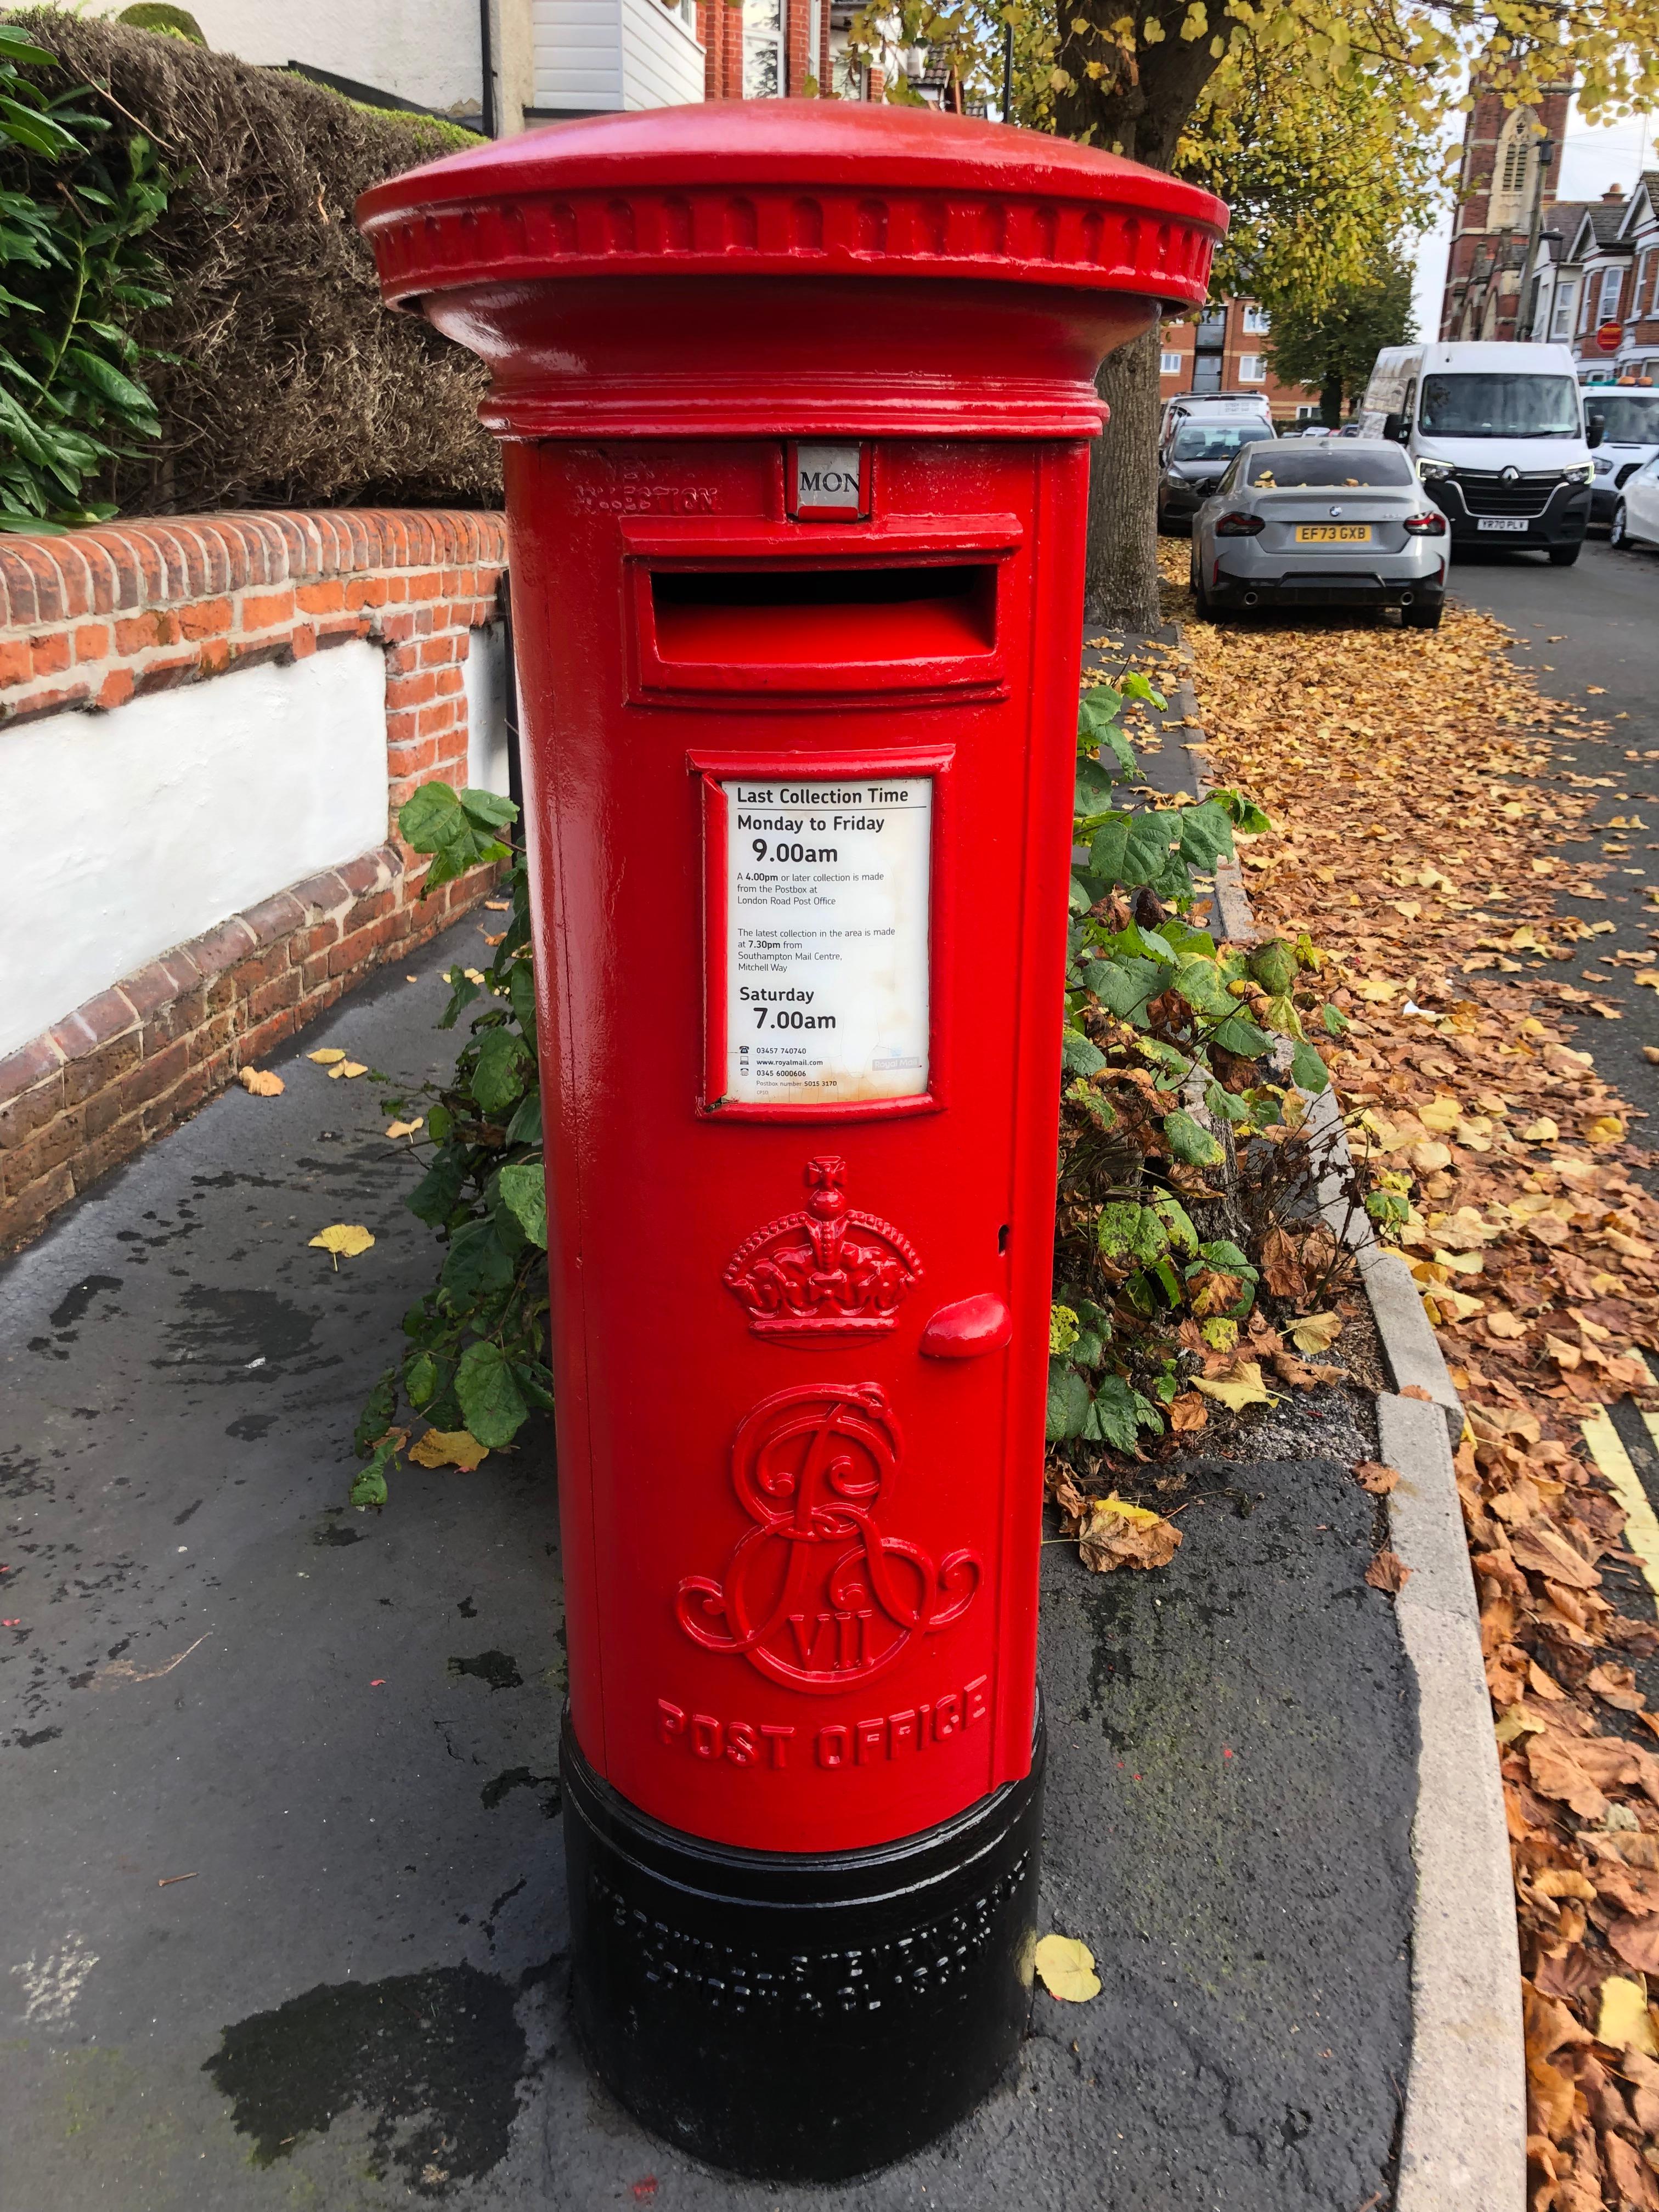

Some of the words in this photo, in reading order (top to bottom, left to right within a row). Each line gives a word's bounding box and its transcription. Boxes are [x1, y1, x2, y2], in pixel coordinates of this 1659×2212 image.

[799, 472, 860, 492] MON
[1301, 527, 1337, 540] EF73
[1340, 527, 1365, 539] GXB
[737, 787, 773, 803] Last
[780, 788, 862, 804] Collection
[867, 788, 909, 803] Time
[738, 815, 803, 834] Monday
[810, 817, 826, 831] to
[834, 816, 884, 833] Friday
[752, 839, 837, 862] 9.00am
[746, 873, 778, 883] 4.00pm
[792, 873, 809, 882] later
[813, 873, 850, 882] collection
[853, 873, 859, 881] is
[775, 885, 806, 894] Postbox
[738, 896, 768, 905] London
[738, 928, 753, 936] The
[756, 929, 777, 937] latest
[780, 929, 816, 938] collection
[820, 929, 827, 938] in
[830, 929, 842, 938] the
[873, 928, 895, 936] made
[748, 940, 780, 950] 7.30pm
[738, 952, 792, 962] Southampton
[795, 952, 811, 960] Mail
[814, 952, 842, 961] Centre,
[770, 964, 787, 973] Way
[740, 987, 814, 1004] Saturday
[753, 1007, 836, 1029] 7.00am
[875, 1060, 898, 1069] Royal
[900, 1058, 918, 1066] Mail
[790, 1609, 876, 1671] VII
[658, 1698, 795, 1770] POST
[817, 1674, 988, 1770] OFFICE
